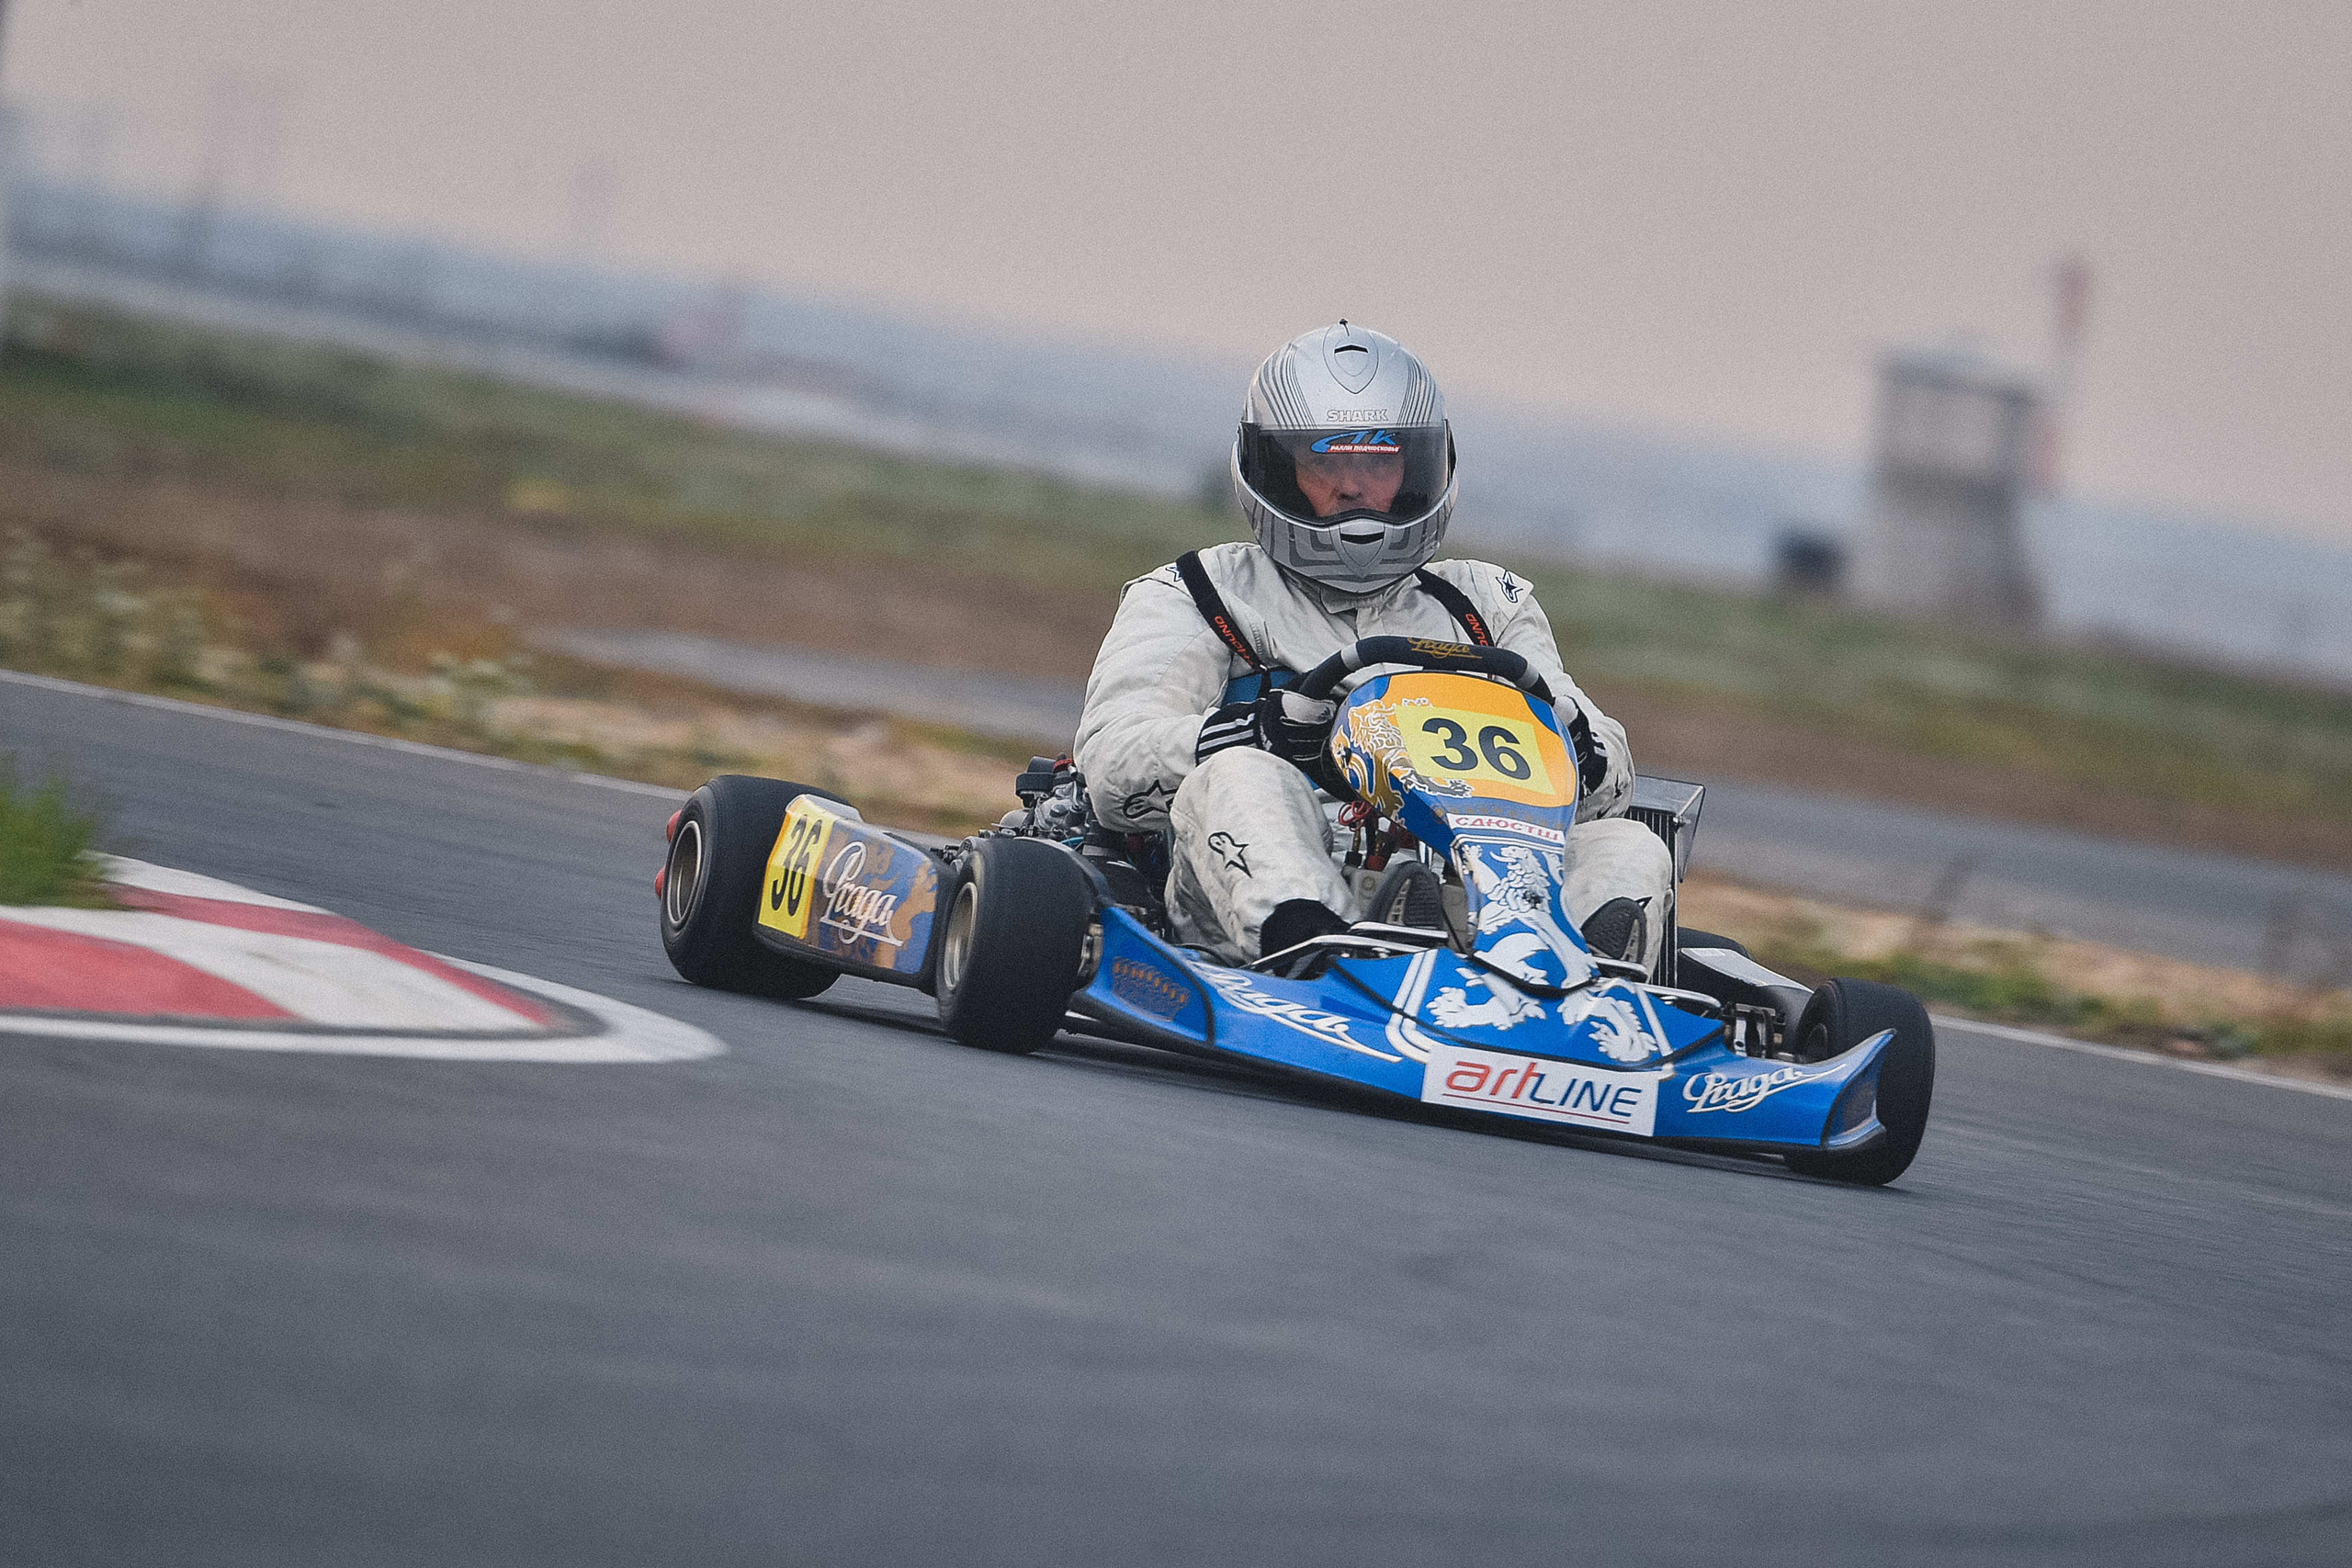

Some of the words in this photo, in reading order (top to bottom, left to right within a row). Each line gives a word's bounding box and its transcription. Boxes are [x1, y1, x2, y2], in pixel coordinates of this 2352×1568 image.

[1327, 409, 1389, 422] SHARK
[1465, 613, 1488, 647] OUND
[1422, 717, 1532, 780] 36
[771, 814, 822, 917] 36
[820, 841, 904, 947] Praga
[1682, 1063, 1847, 1113] Praga
